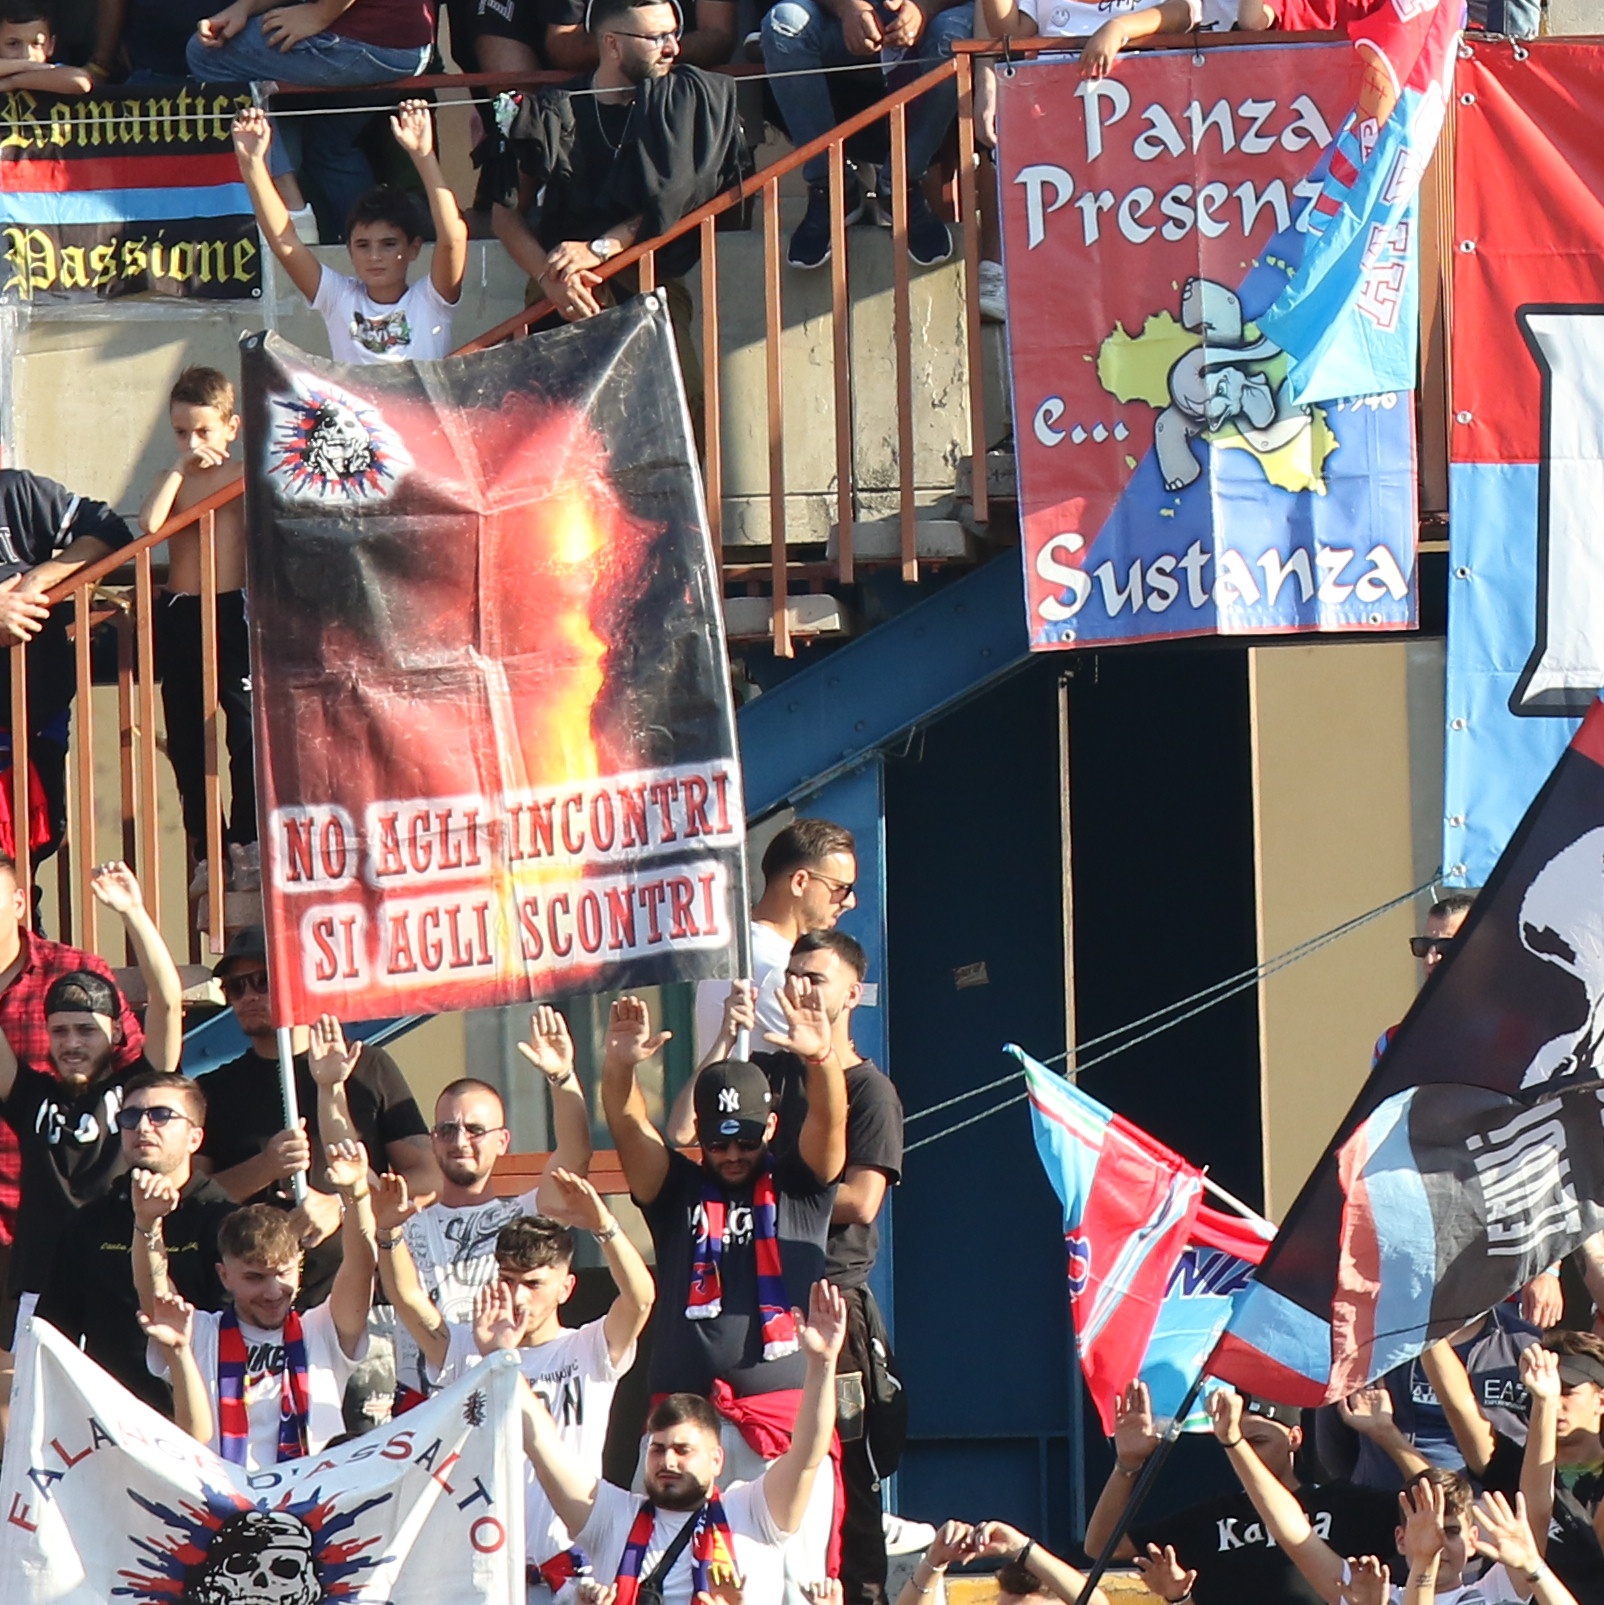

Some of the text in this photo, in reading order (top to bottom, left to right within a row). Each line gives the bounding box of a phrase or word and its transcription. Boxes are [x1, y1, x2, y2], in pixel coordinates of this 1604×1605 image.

[1074, 77, 1334, 164] Panza
[1013, 164, 1328, 250] Presenz
[3, 224, 258, 300] Passione
[1036, 531, 1409, 622] Sustanza
[283, 769, 734, 880] NO AGLI INCONTRI
[312, 869, 719, 982] SI AGLI SCONTRI
[718, 1087, 740, 1112] NY
[12, 1414, 508, 1554] FALANGE D'ASSALTO
[1216, 1512, 1333, 1552] Kapa
